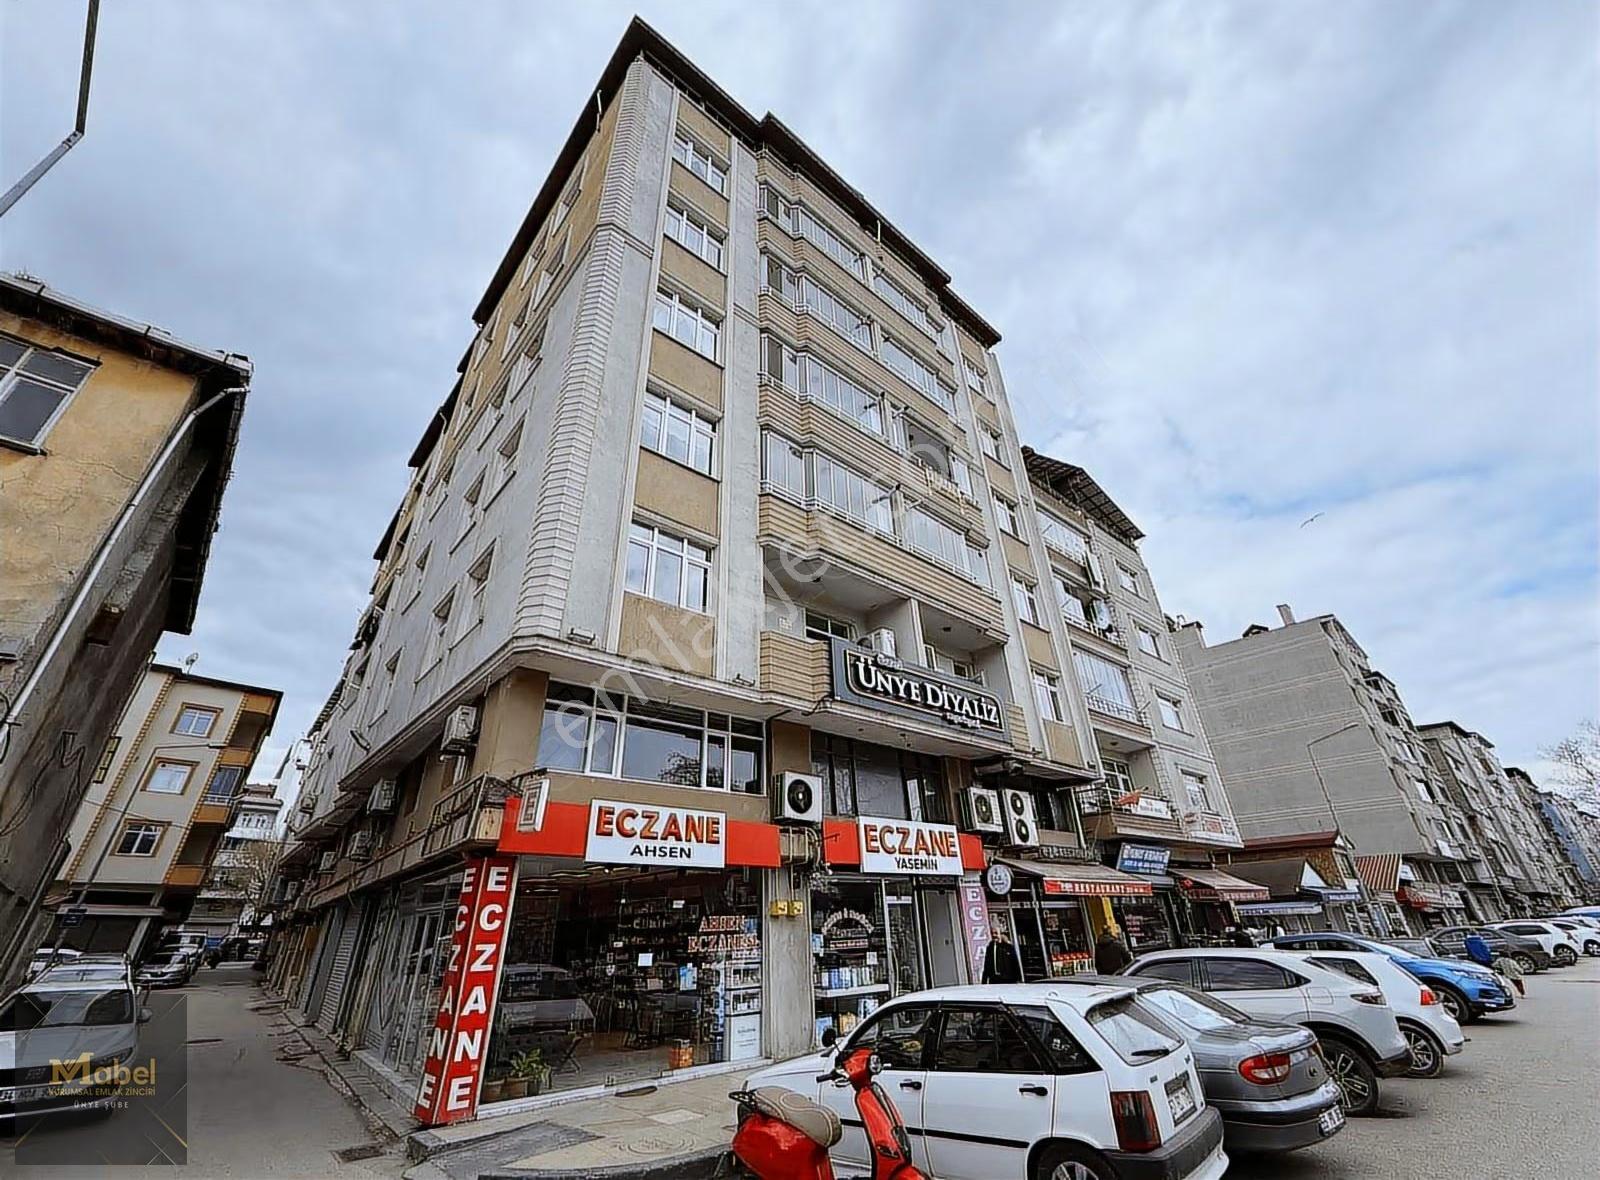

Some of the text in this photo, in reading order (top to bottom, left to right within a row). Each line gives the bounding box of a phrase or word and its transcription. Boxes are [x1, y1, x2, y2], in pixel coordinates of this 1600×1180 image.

[856, 657, 922, 702] ÜNYE
[924, 682, 1000, 727] DİYALİZ
[596, 806, 720, 844] ECZANE
[630, 845, 692, 858] AHSEN
[864, 824, 958, 857] ECZANE
[418, 867, 477, 1109] ECZANE
[447, 866, 509, 1111] ECZANE
